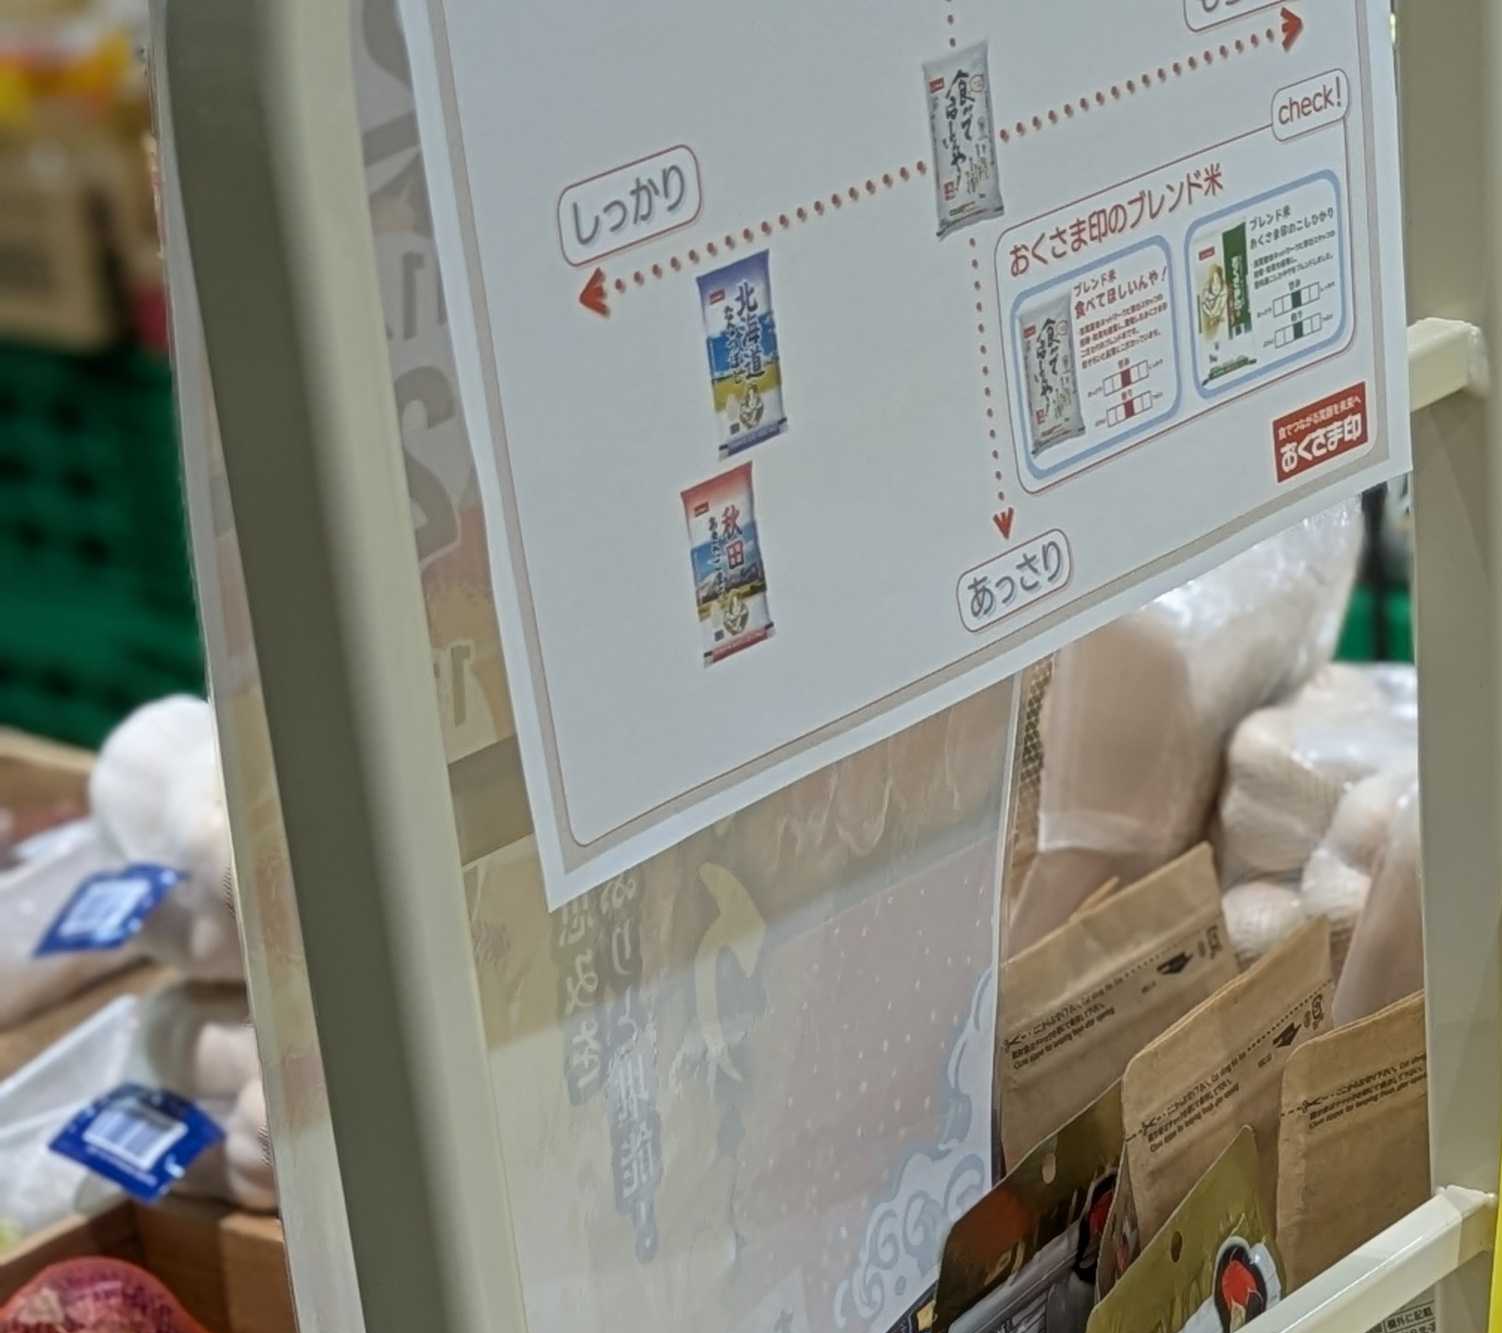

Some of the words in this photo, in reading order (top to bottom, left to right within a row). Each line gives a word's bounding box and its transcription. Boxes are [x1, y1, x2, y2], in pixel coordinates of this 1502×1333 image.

[1278, 76, 1342, 125] check!
[573, 165, 685, 245] しっかり
[1009, 163, 1224, 278] おくさま印のブレンド米
[1280, 413, 1362, 472] おくさま印
[968, 541, 1061, 617] あっさり
